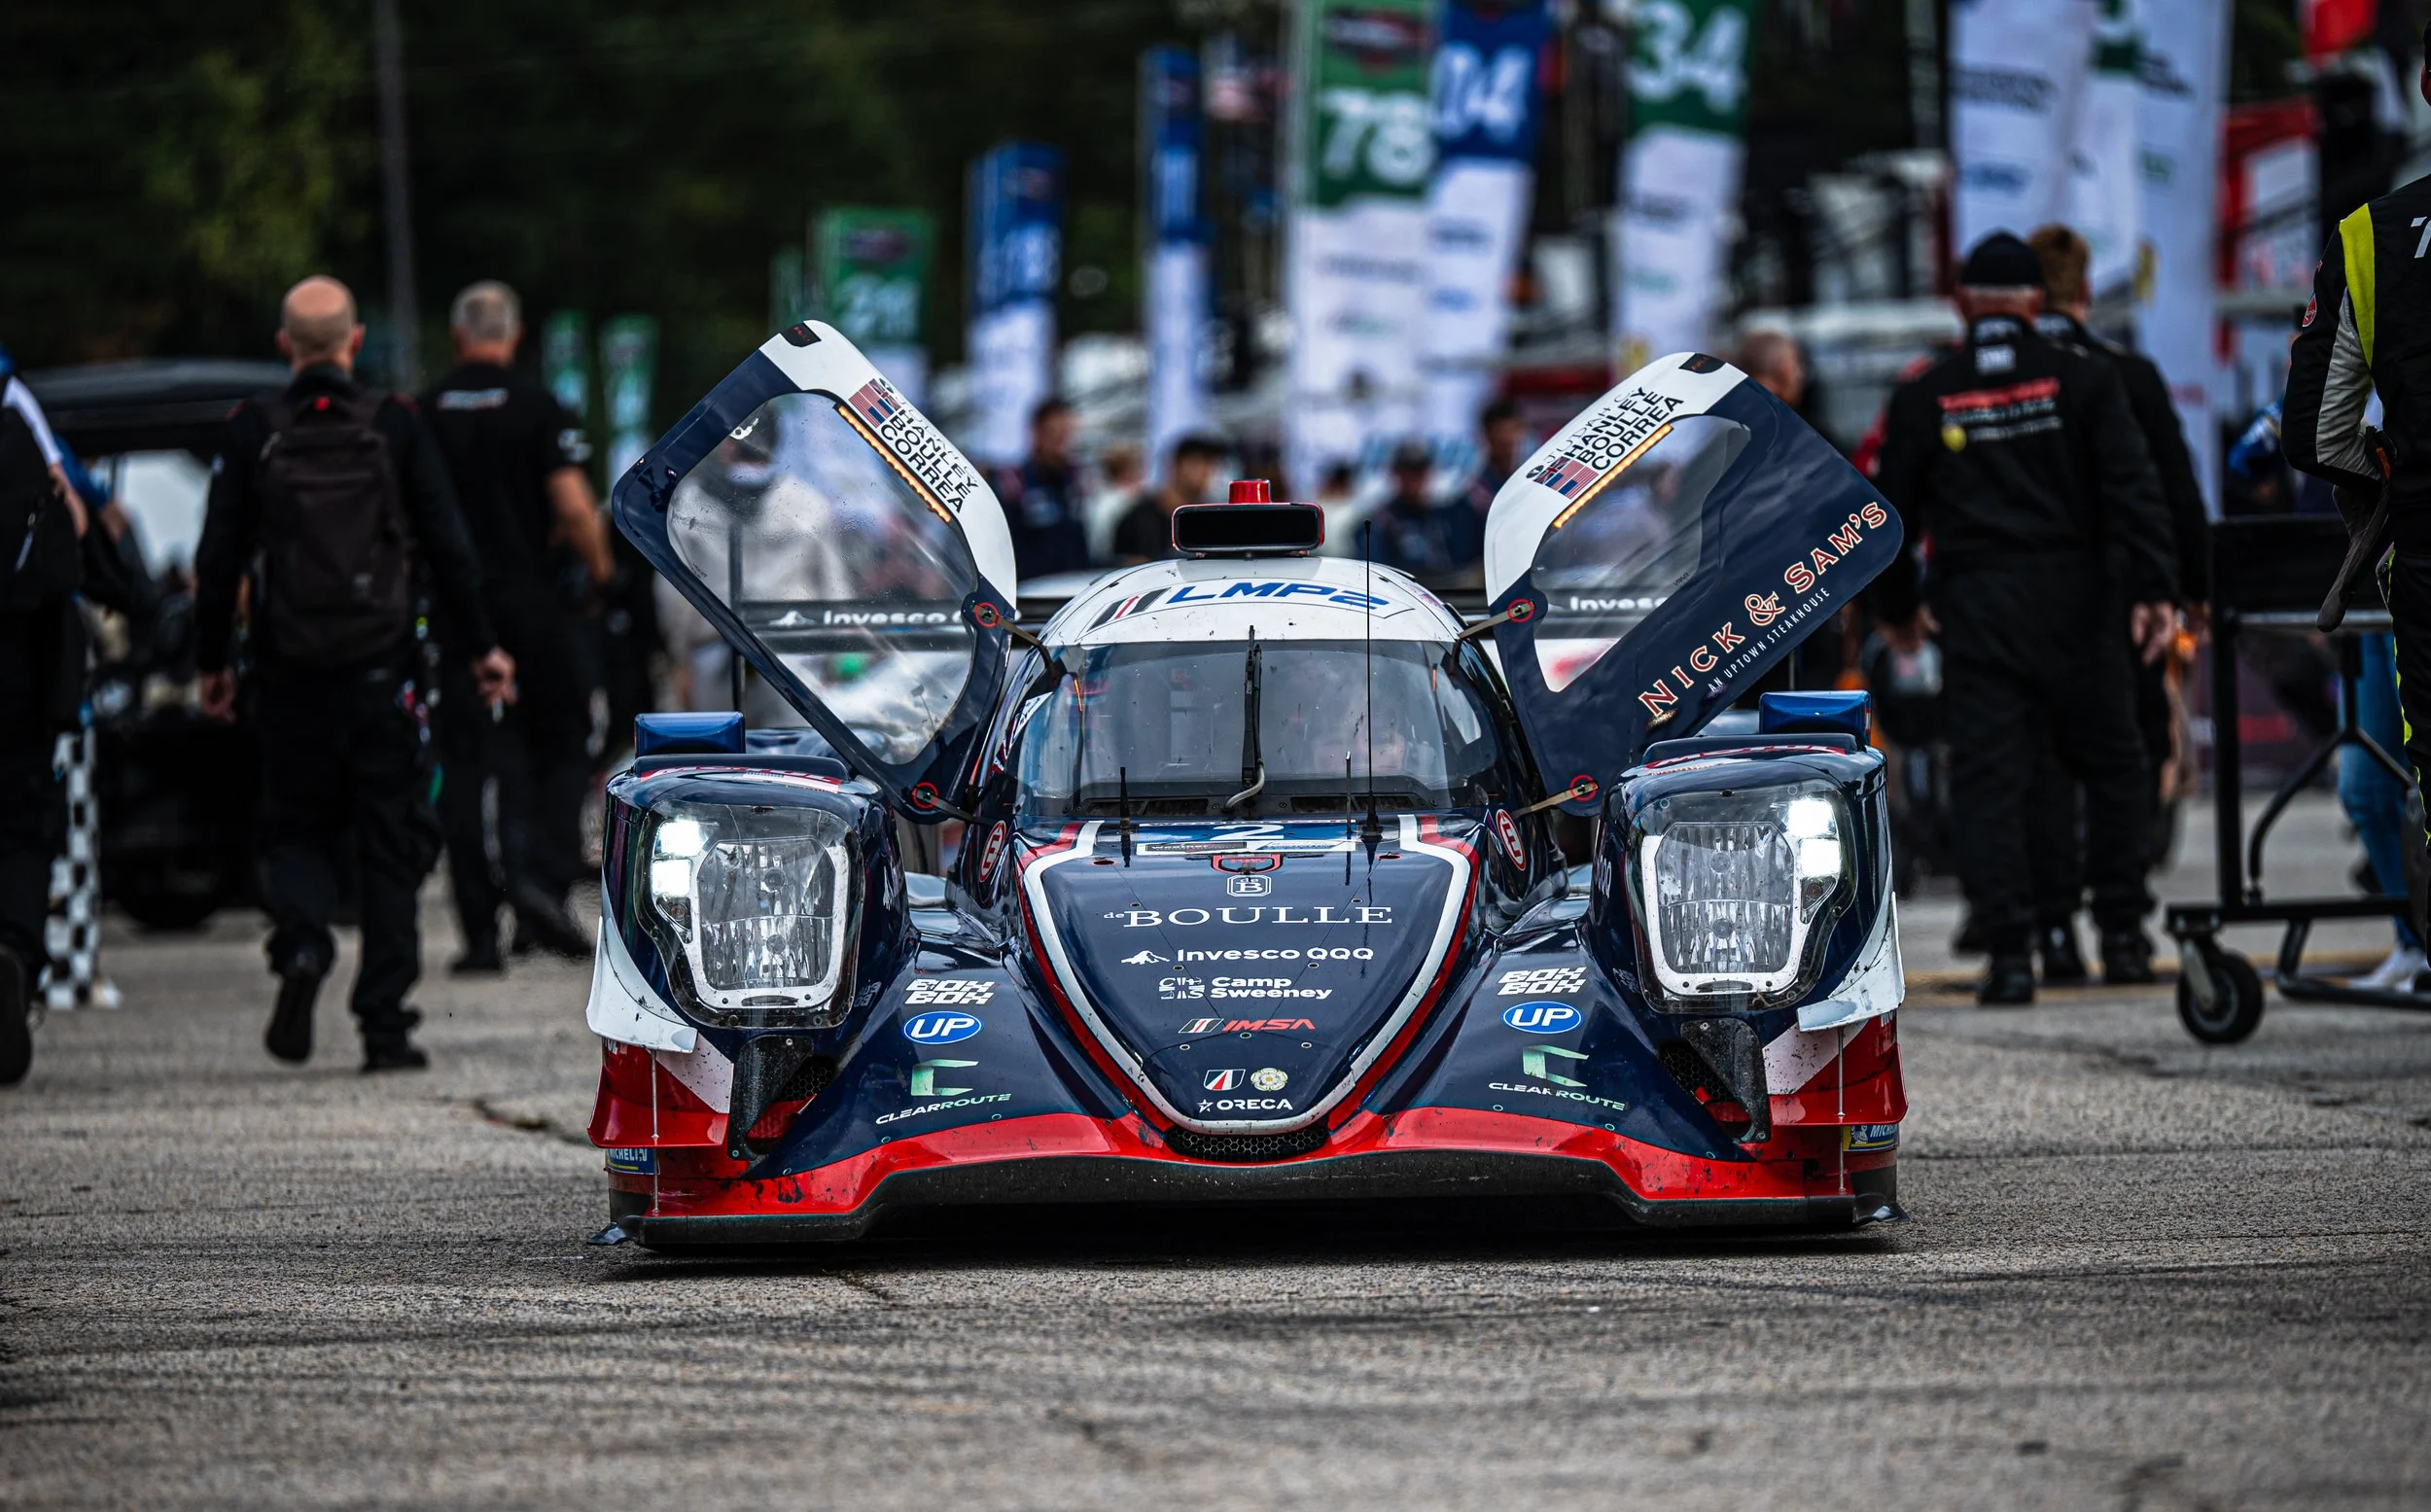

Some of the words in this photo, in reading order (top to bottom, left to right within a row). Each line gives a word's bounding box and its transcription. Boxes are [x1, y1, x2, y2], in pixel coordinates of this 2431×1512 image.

[1622, 2, 1747, 115] 34
[1322, 89, 1435, 185] 78
[1564, 387, 1646, 458] HANLEY
[1575, 391, 1664, 464] BOULLE
[1591, 397, 1684, 471] CORREA
[889, 415, 970, 499] BOULLE
[898, 408, 979, 488] HANLEY
[880, 424, 965, 513] CORREA
[1166, 581, 1391, 610] LMP2
[1569, 596, 1668, 612] Inves
[824, 610, 947, 625] Invesco
[1708, 677, 1723, 692] AN
[1722, 641, 1767, 680] UPTOWN
[1766, 586, 1831, 645] STEAKHOUSE
[1638, 621, 1746, 718] NICK
[1744, 590, 1786, 627] &
[1210, 825, 1285, 840] 2
[1177, 948, 1301, 962] Invesco
[1306, 947, 1374, 961] QQQ
[905, 978, 996, 992] BOX
[1212, 976, 1292, 989] Camp
[1497, 967, 1588, 984] BOX
[904, 991, 995, 1004] BOX
[1210, 987, 1333, 1000] Sweeney
[1497, 979, 1587, 996] BOX
[910, 1017, 975, 1038] UP
[1221, 1018, 1316, 1032] IMSA
[1511, 1008, 1574, 1027] UP
[1216, 1099, 1293, 1110] ORECA
[1488, 1082, 1626, 1111] CLEARROUTE
[875, 1093, 1012, 1125] CLEARROUTE
